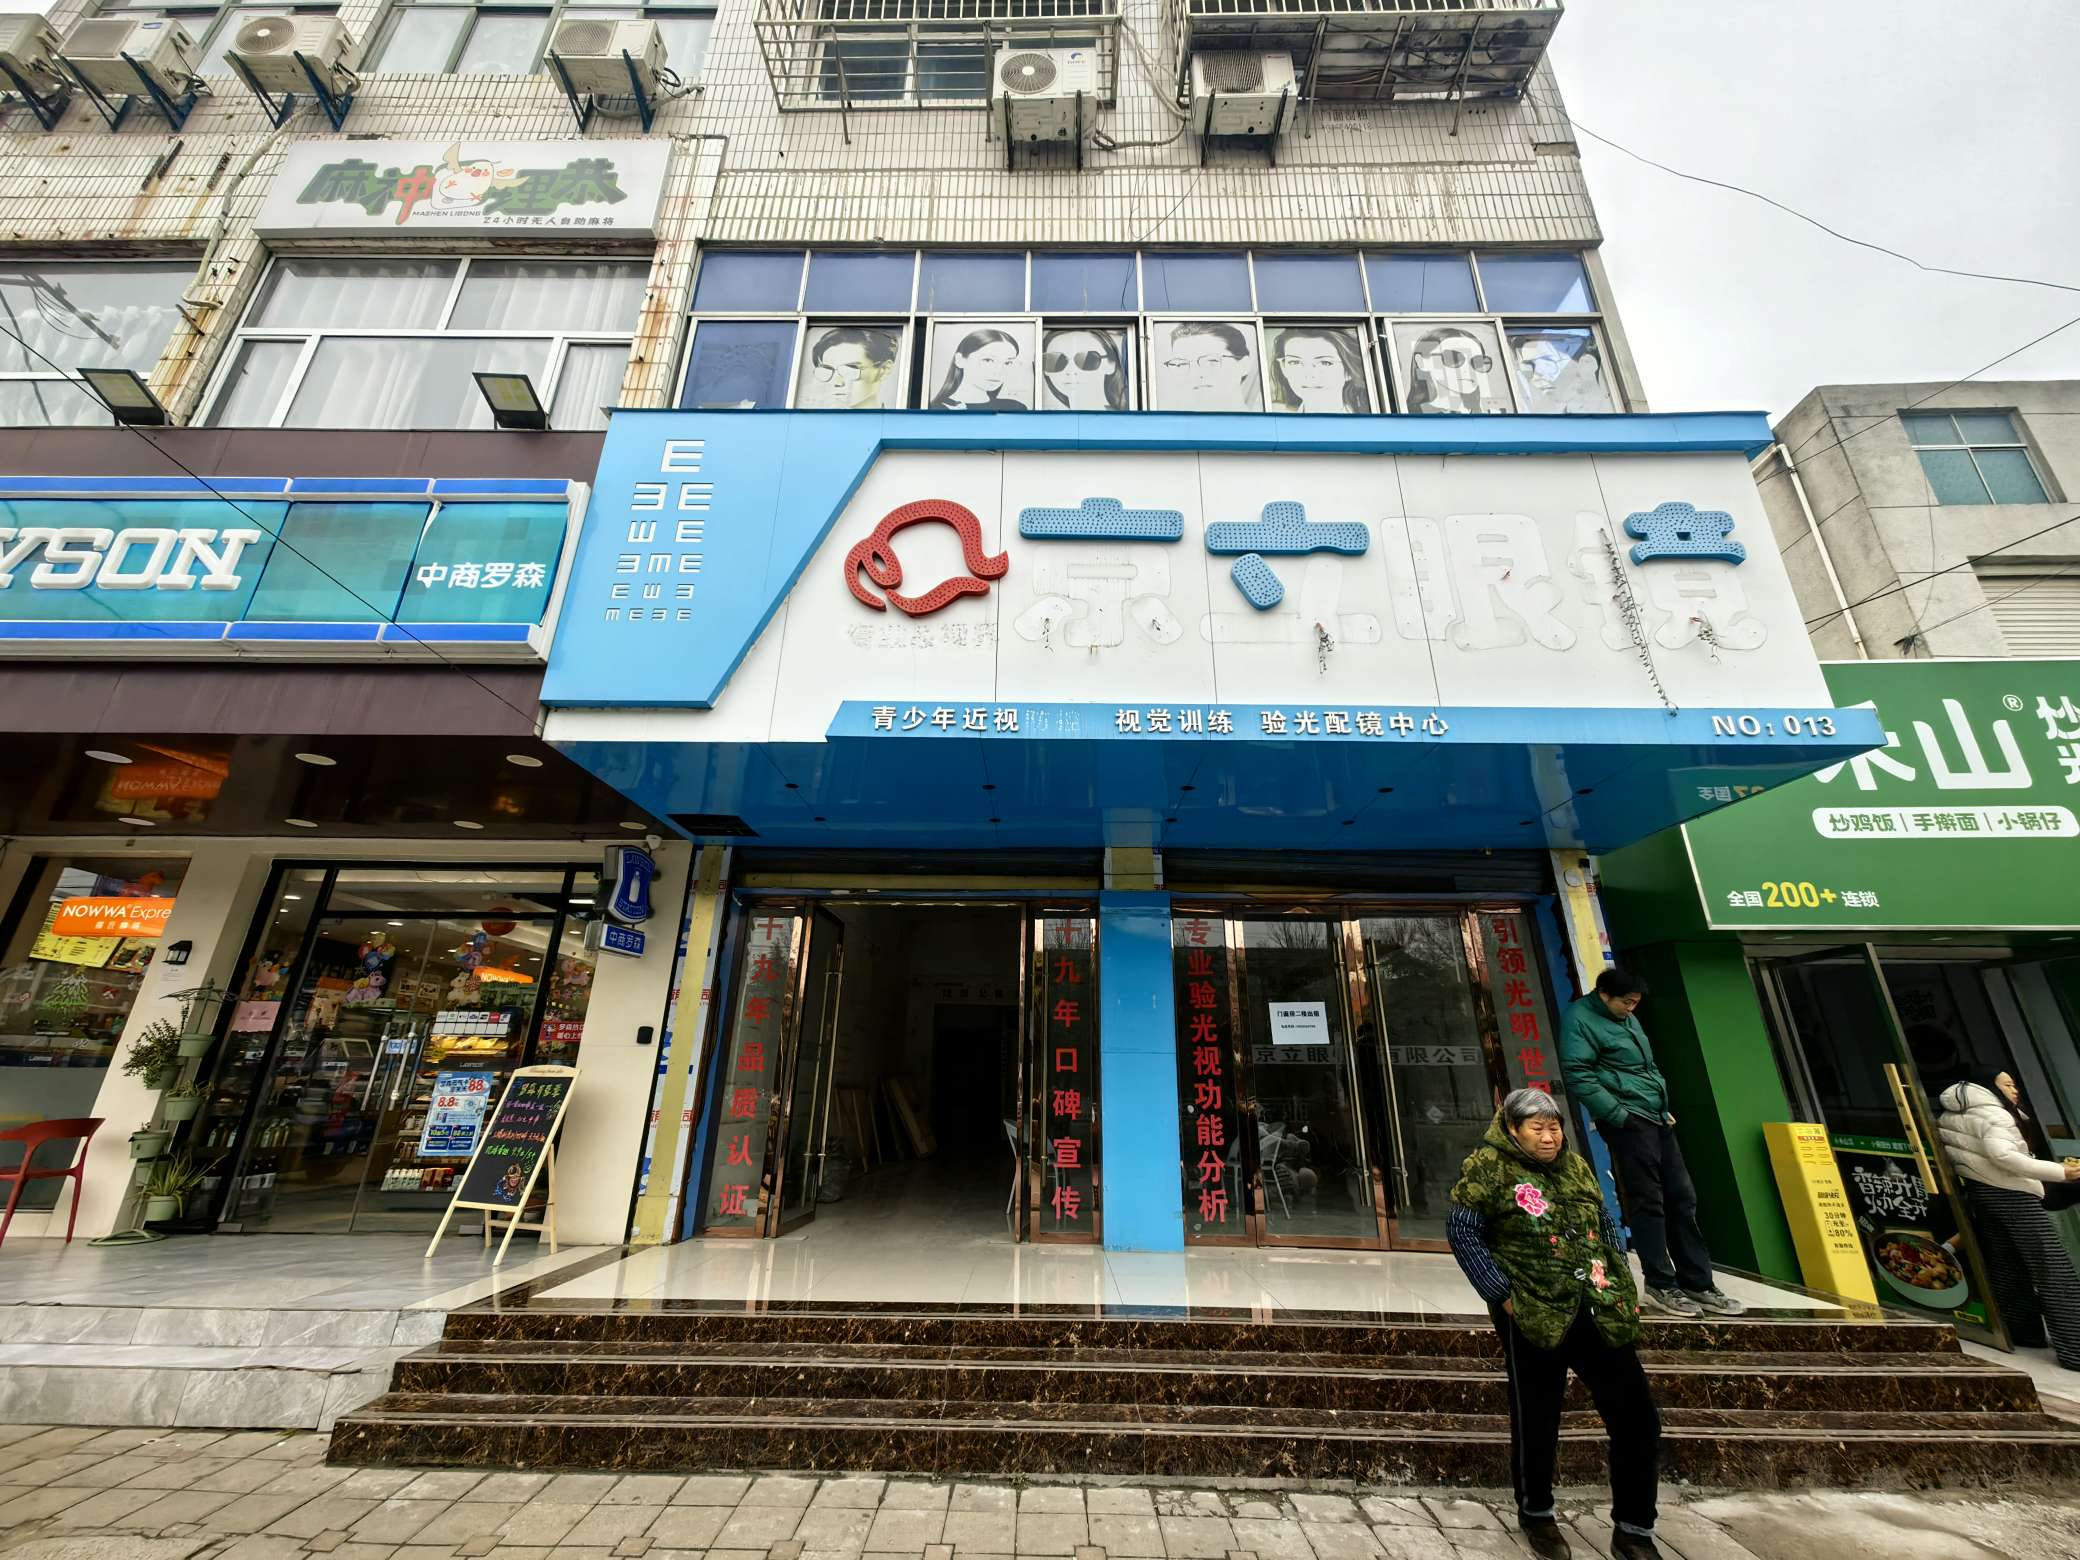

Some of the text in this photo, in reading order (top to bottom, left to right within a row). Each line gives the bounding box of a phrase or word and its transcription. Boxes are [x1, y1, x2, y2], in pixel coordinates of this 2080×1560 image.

[417, 562, 546, 588] 中商罗森
[1114, 708, 1235, 734] 视觉训练
[1260, 710, 1449, 737] 验光配镜中心
[1829, 812, 2062, 832] 炒鸡饭 手擀面 小锅仔
[62, 905, 127, 918] NOWWA
[718, 914, 784, 1217] 十九年品质认证
[1051, 918, 1083, 1221] 十九年口碑宣传
[1183, 919, 1229, 1224] 专业验光视功能分析
